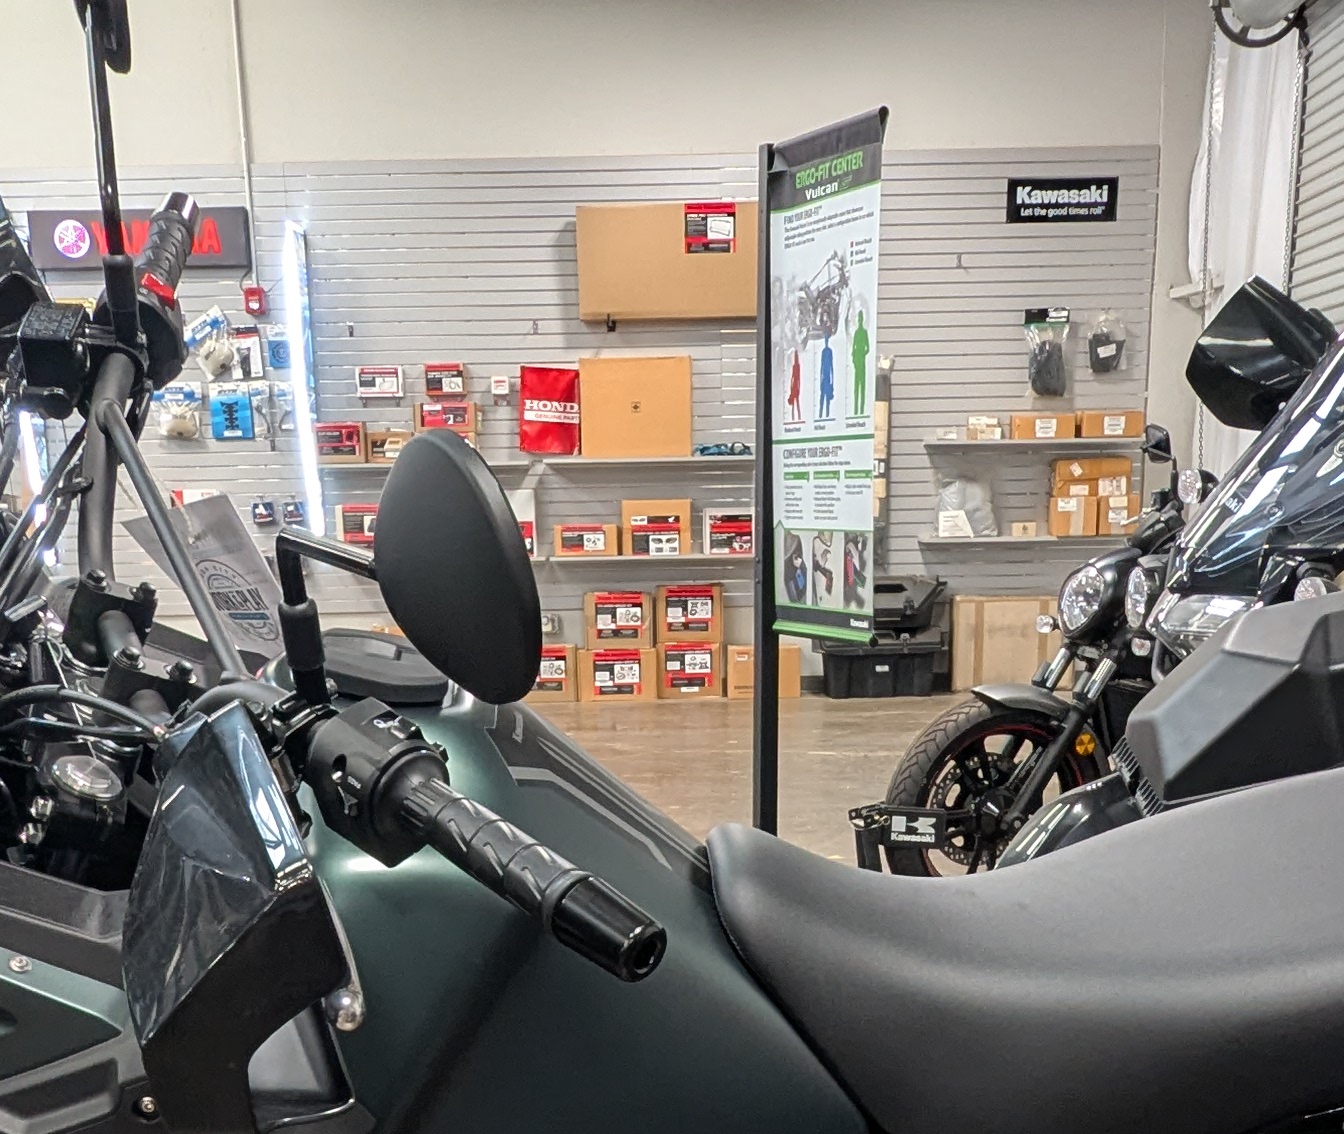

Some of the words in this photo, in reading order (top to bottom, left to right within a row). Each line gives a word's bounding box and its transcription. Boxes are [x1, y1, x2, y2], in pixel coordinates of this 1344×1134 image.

[795, 162, 831, 190] ERGO-FIT
[831, 150, 864, 177] CENTER
[805, 181, 838, 200] Vulcan
[1016, 184, 1109, 205] Kawasaki
[1020, 207, 1033, 217] Let
[1034, 206, 1047, 216] the
[1048, 205, 1068, 218] good
[1069, 206, 1089, 215] times
[524, 399, 579, 413] HOND
[890, 832, 935, 843] Kawasaki
